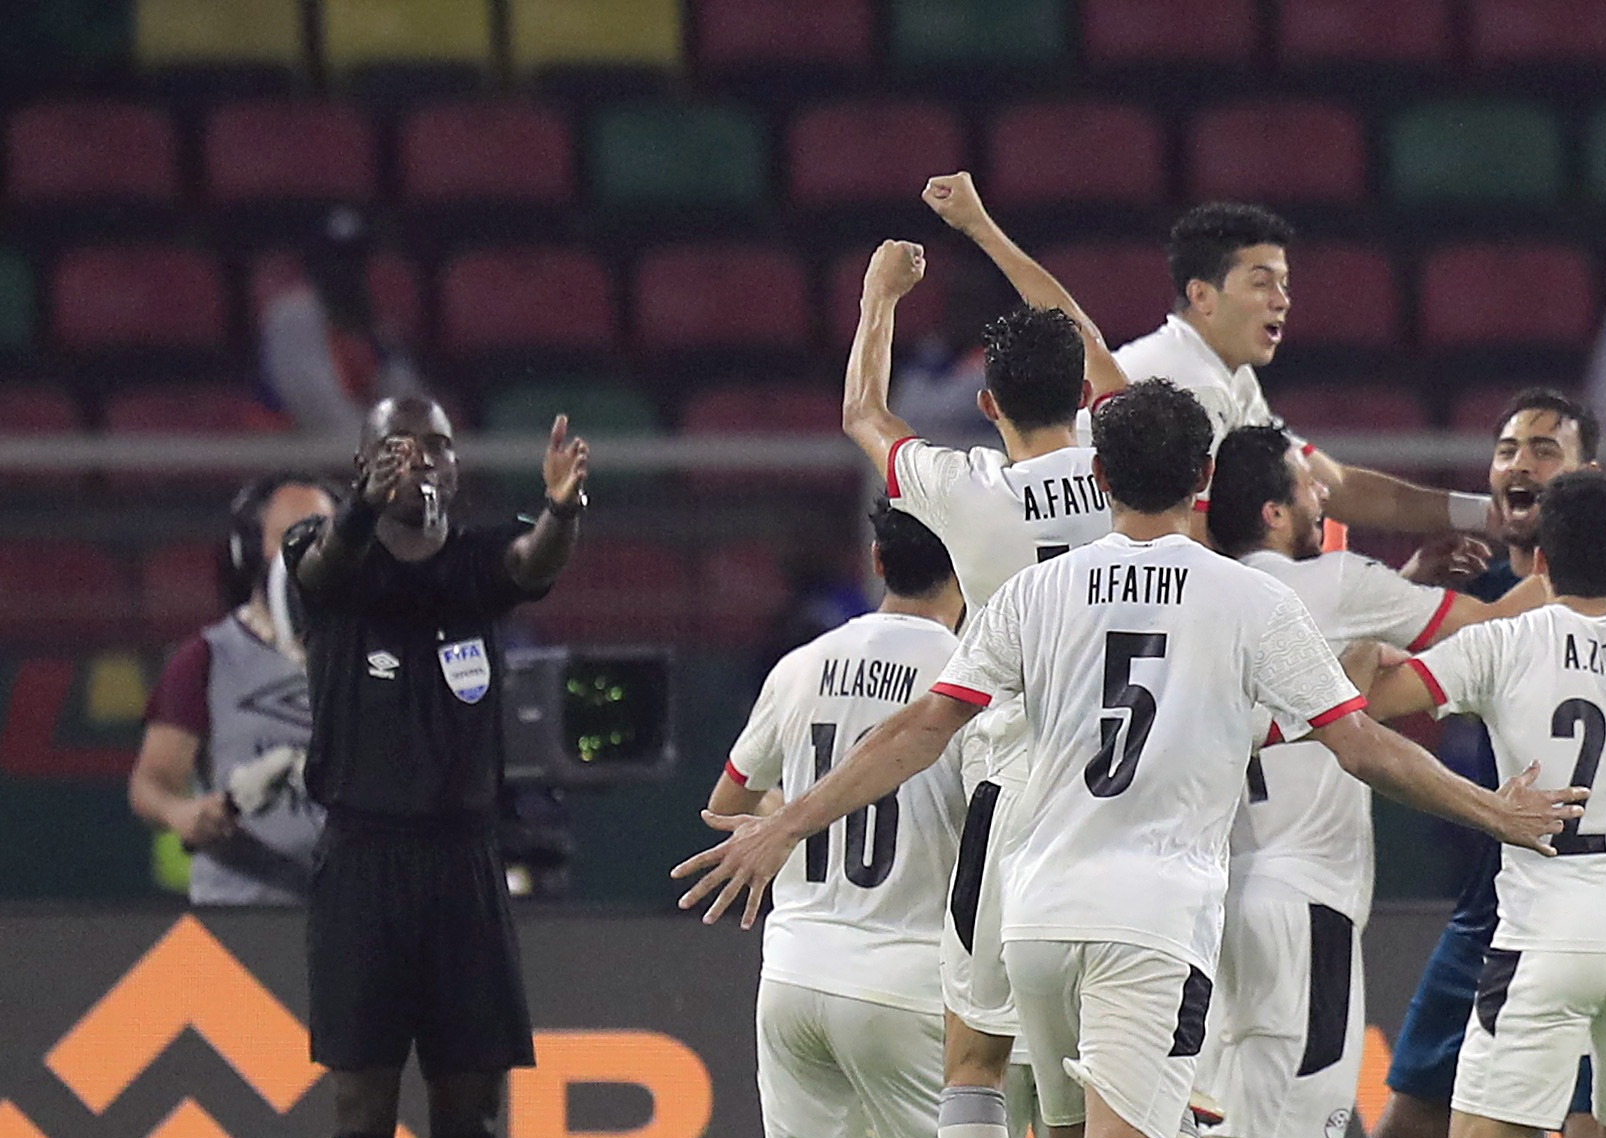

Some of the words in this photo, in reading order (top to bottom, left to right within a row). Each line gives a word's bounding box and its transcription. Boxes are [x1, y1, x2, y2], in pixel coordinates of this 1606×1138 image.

[1024, 475, 1105, 520] A.FATO
[1088, 565, 1188, 605] H.FATHY
[818, 659, 918, 705] M.LASHIN
[1084, 631, 1168, 797] 5
